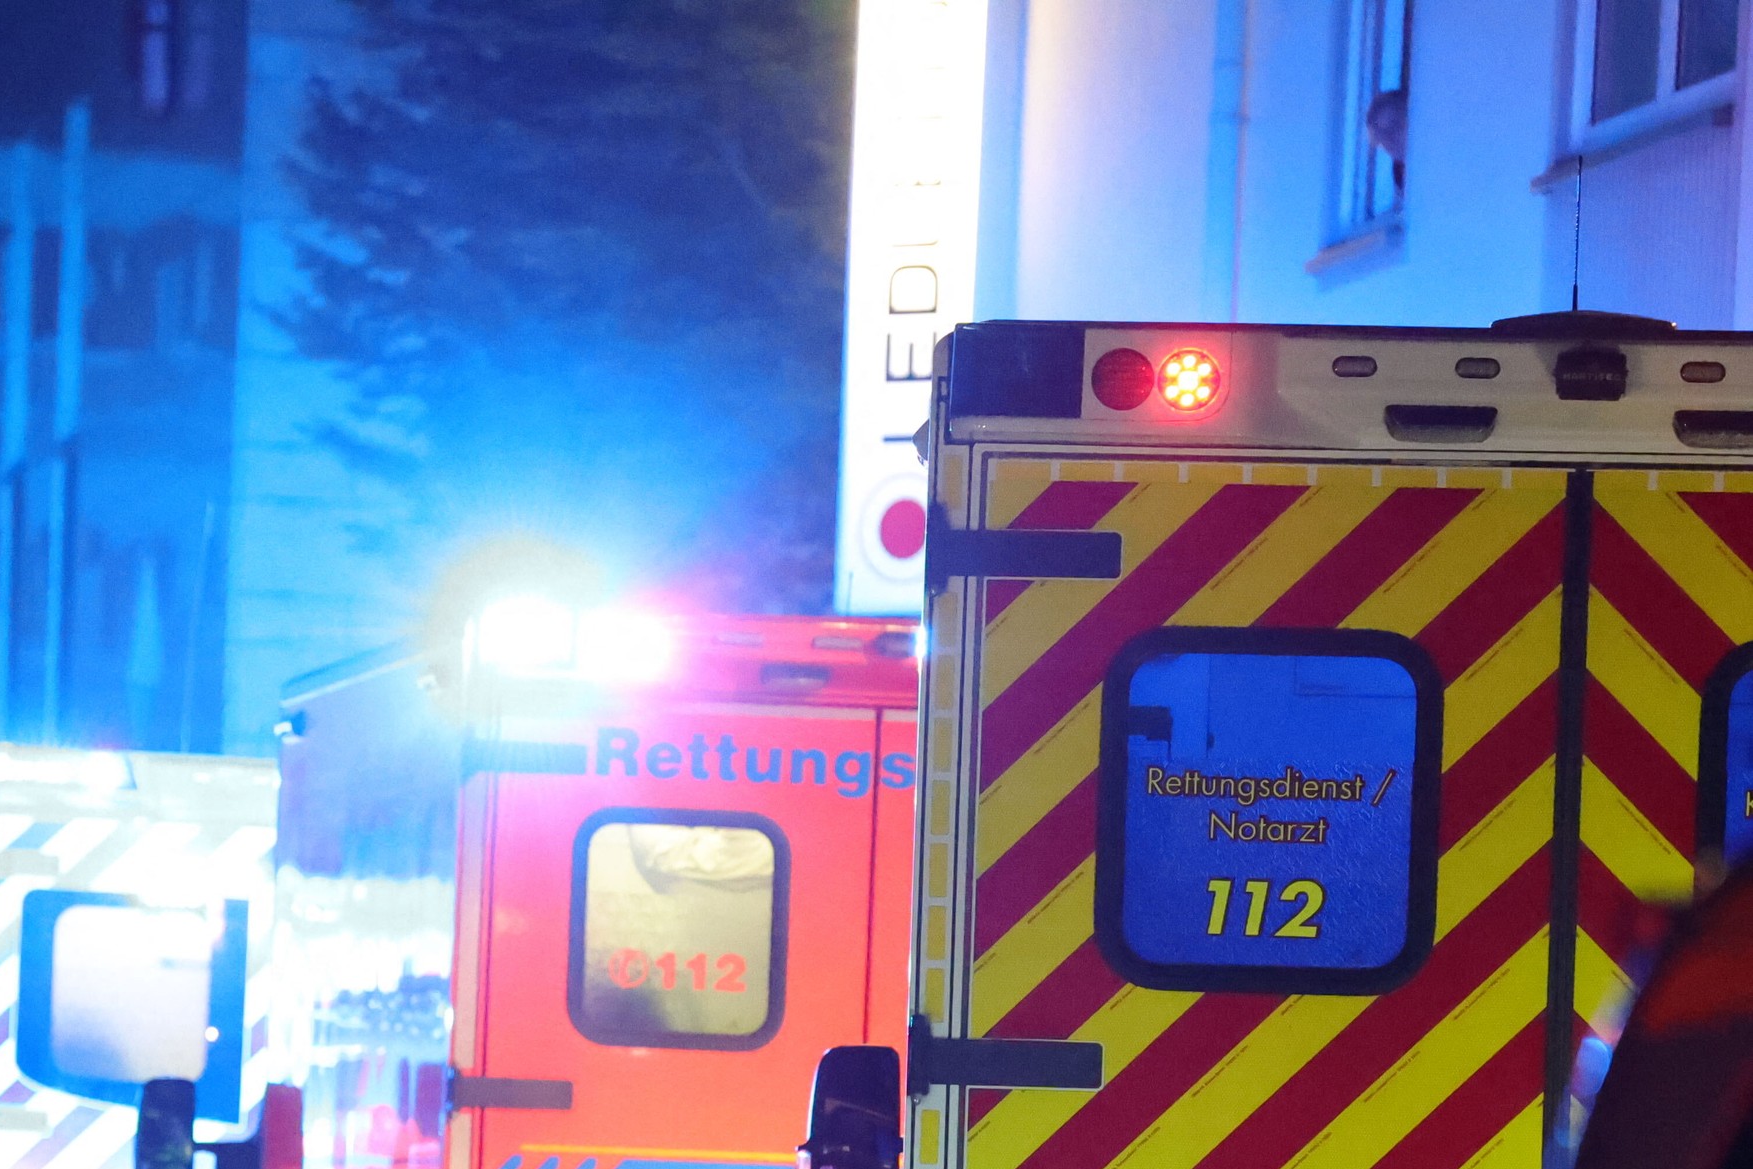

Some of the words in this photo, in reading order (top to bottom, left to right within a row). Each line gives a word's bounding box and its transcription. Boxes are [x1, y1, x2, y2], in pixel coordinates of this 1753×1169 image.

[1146, 766, 1363, 805] Rettungsdienst
[1372, 769, 1397, 807] /
[1209, 813, 1327, 843] Notarzt
[1205, 877, 1325, 939] 112
[655, 952, 747, 993] 112
